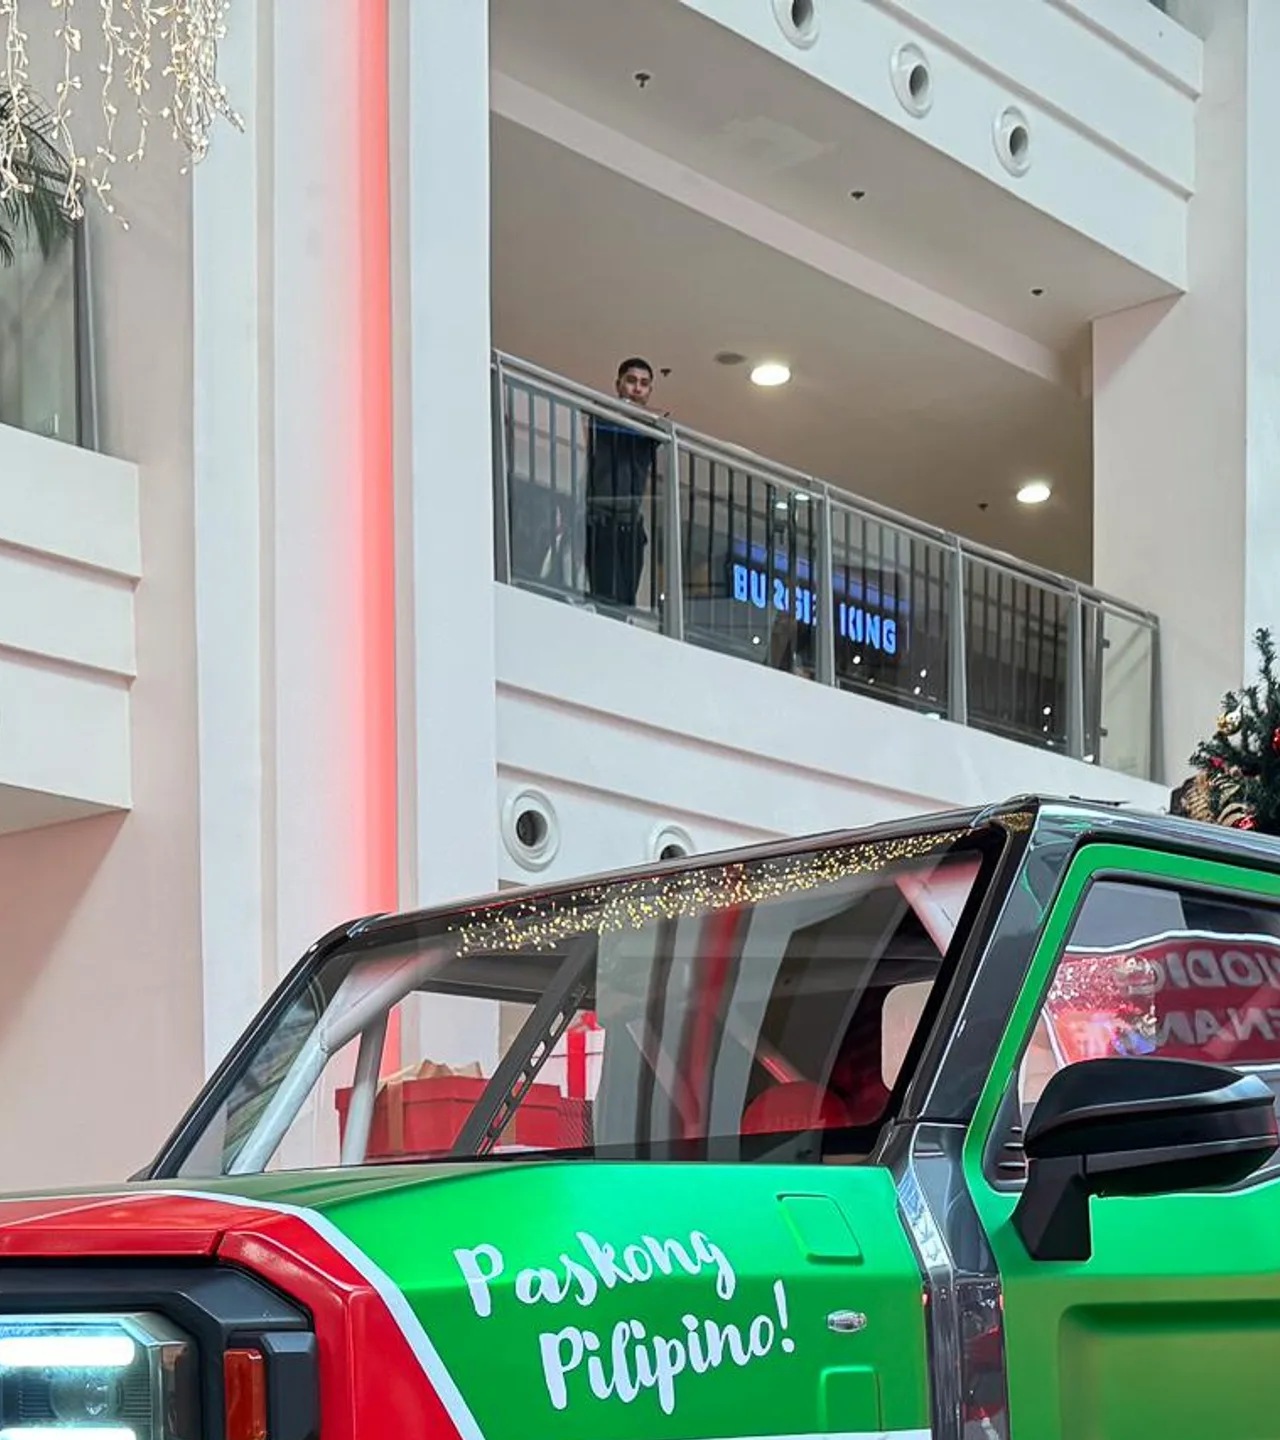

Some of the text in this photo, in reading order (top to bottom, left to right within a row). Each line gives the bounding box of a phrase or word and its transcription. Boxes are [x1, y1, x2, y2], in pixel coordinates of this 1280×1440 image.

[733, 563, 897, 654] BURGE KING
[453, 1230, 736, 1317] Paskong
[539, 1279, 795, 1415] Pilipino!
